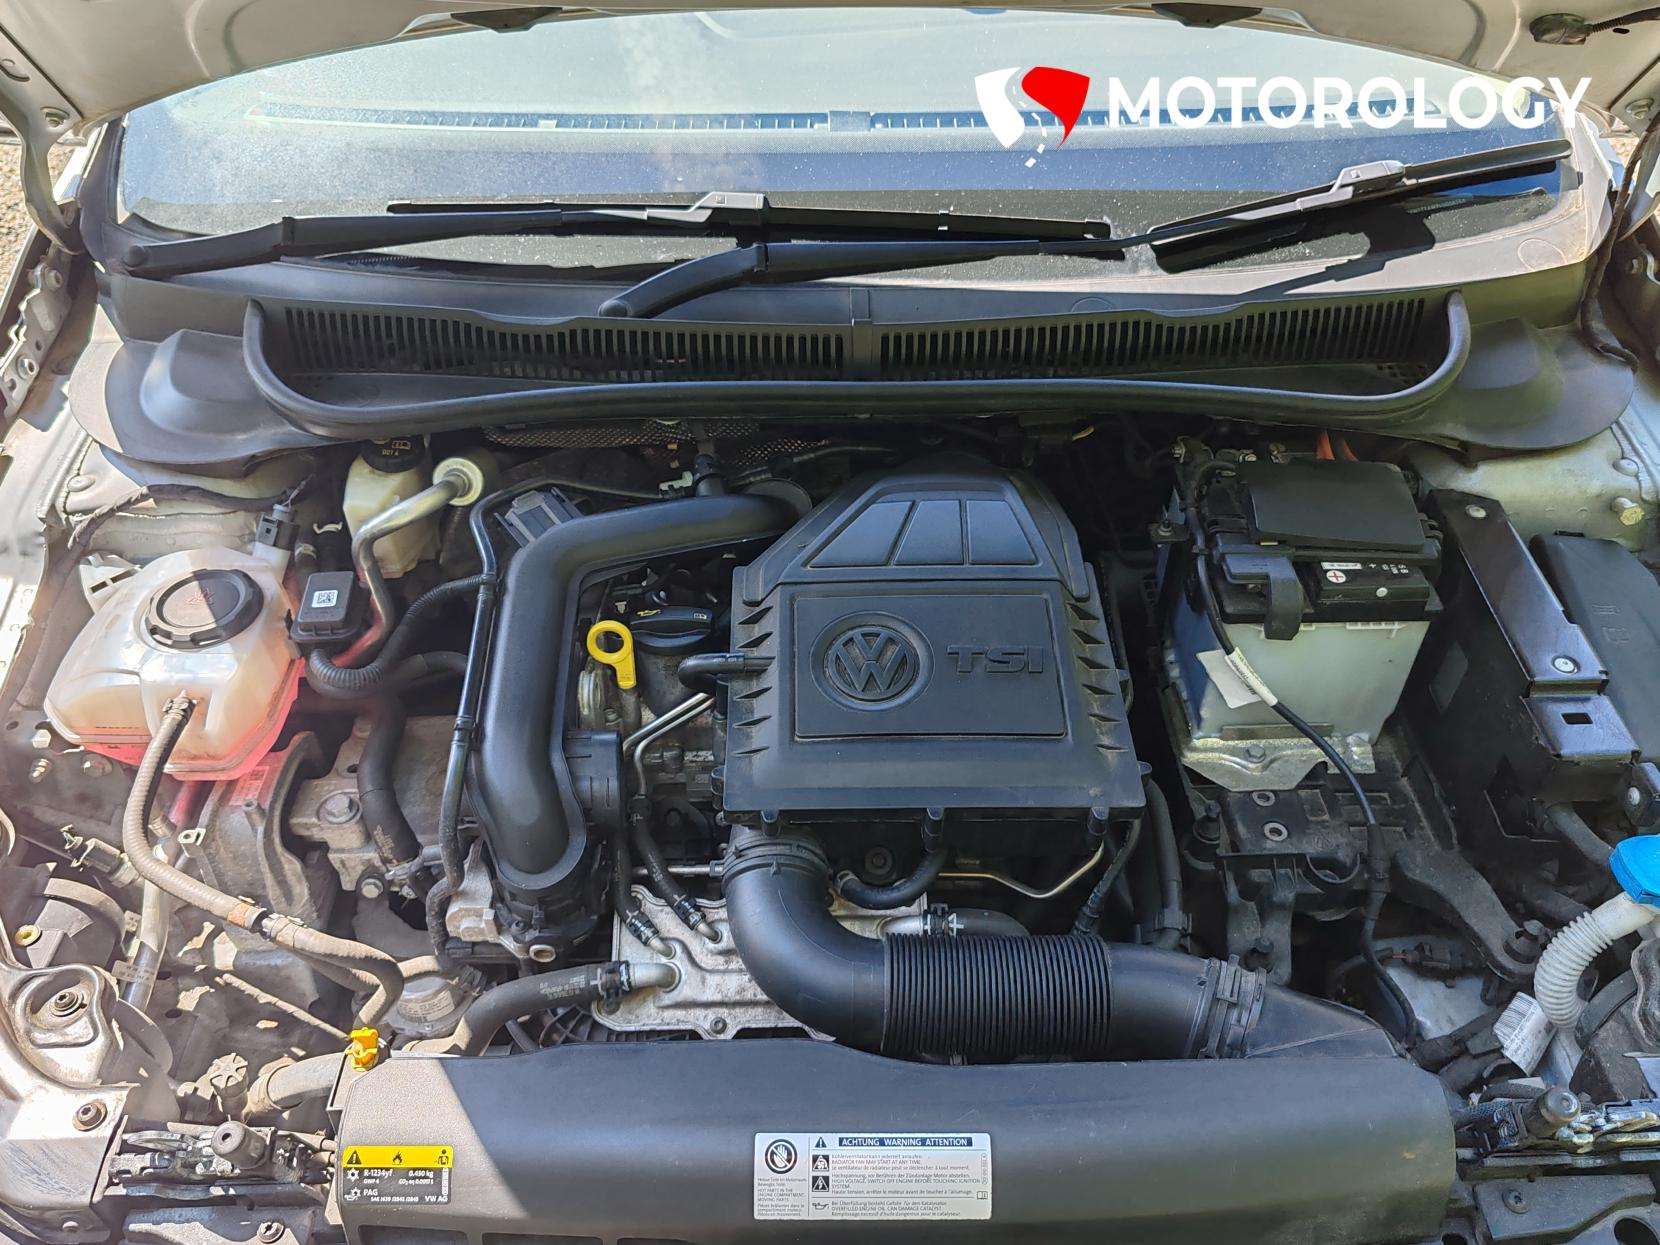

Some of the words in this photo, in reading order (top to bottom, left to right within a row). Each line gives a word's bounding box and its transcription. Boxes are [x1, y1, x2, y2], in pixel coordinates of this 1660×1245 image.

[946, 644, 1044, 673] TSI
[842, 1138, 880, 1146] ACHTUNG
[884, 1138, 922, 1146] WARNING
[926, 1138, 968, 1146] ATTENTION
